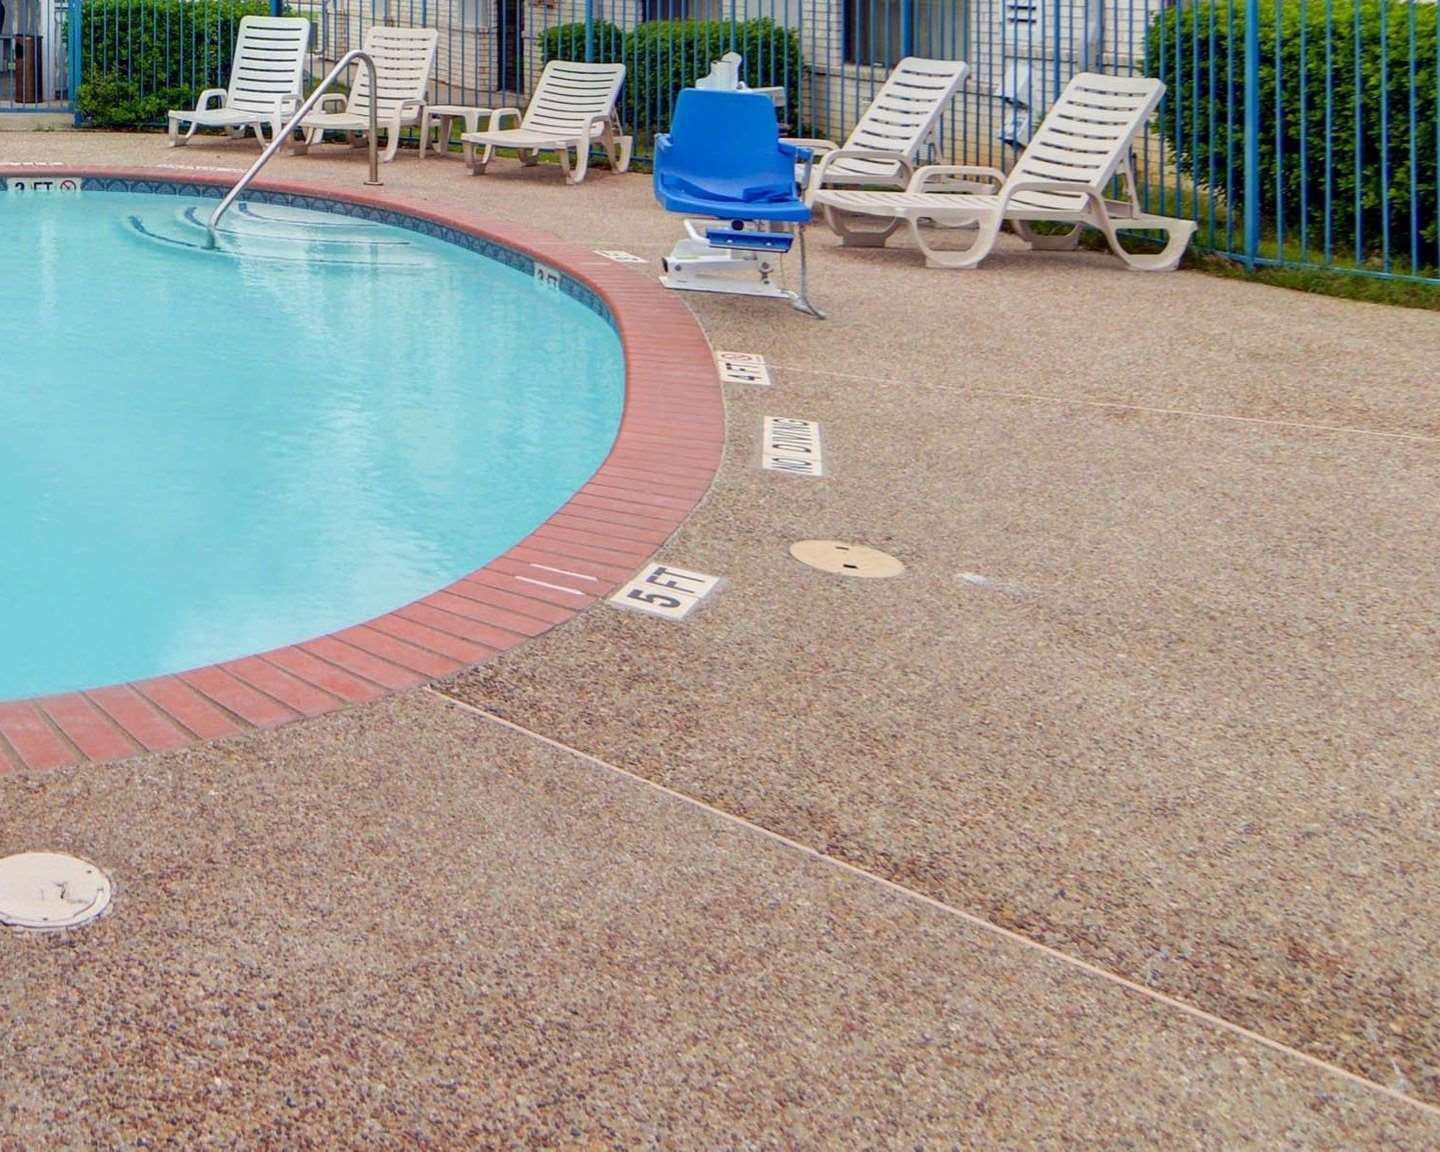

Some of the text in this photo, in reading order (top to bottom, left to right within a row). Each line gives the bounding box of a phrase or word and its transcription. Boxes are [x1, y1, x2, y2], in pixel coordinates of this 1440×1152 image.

[771, 418, 813, 474] NO DIVING
[626, 566, 706, 609] 5 FT
